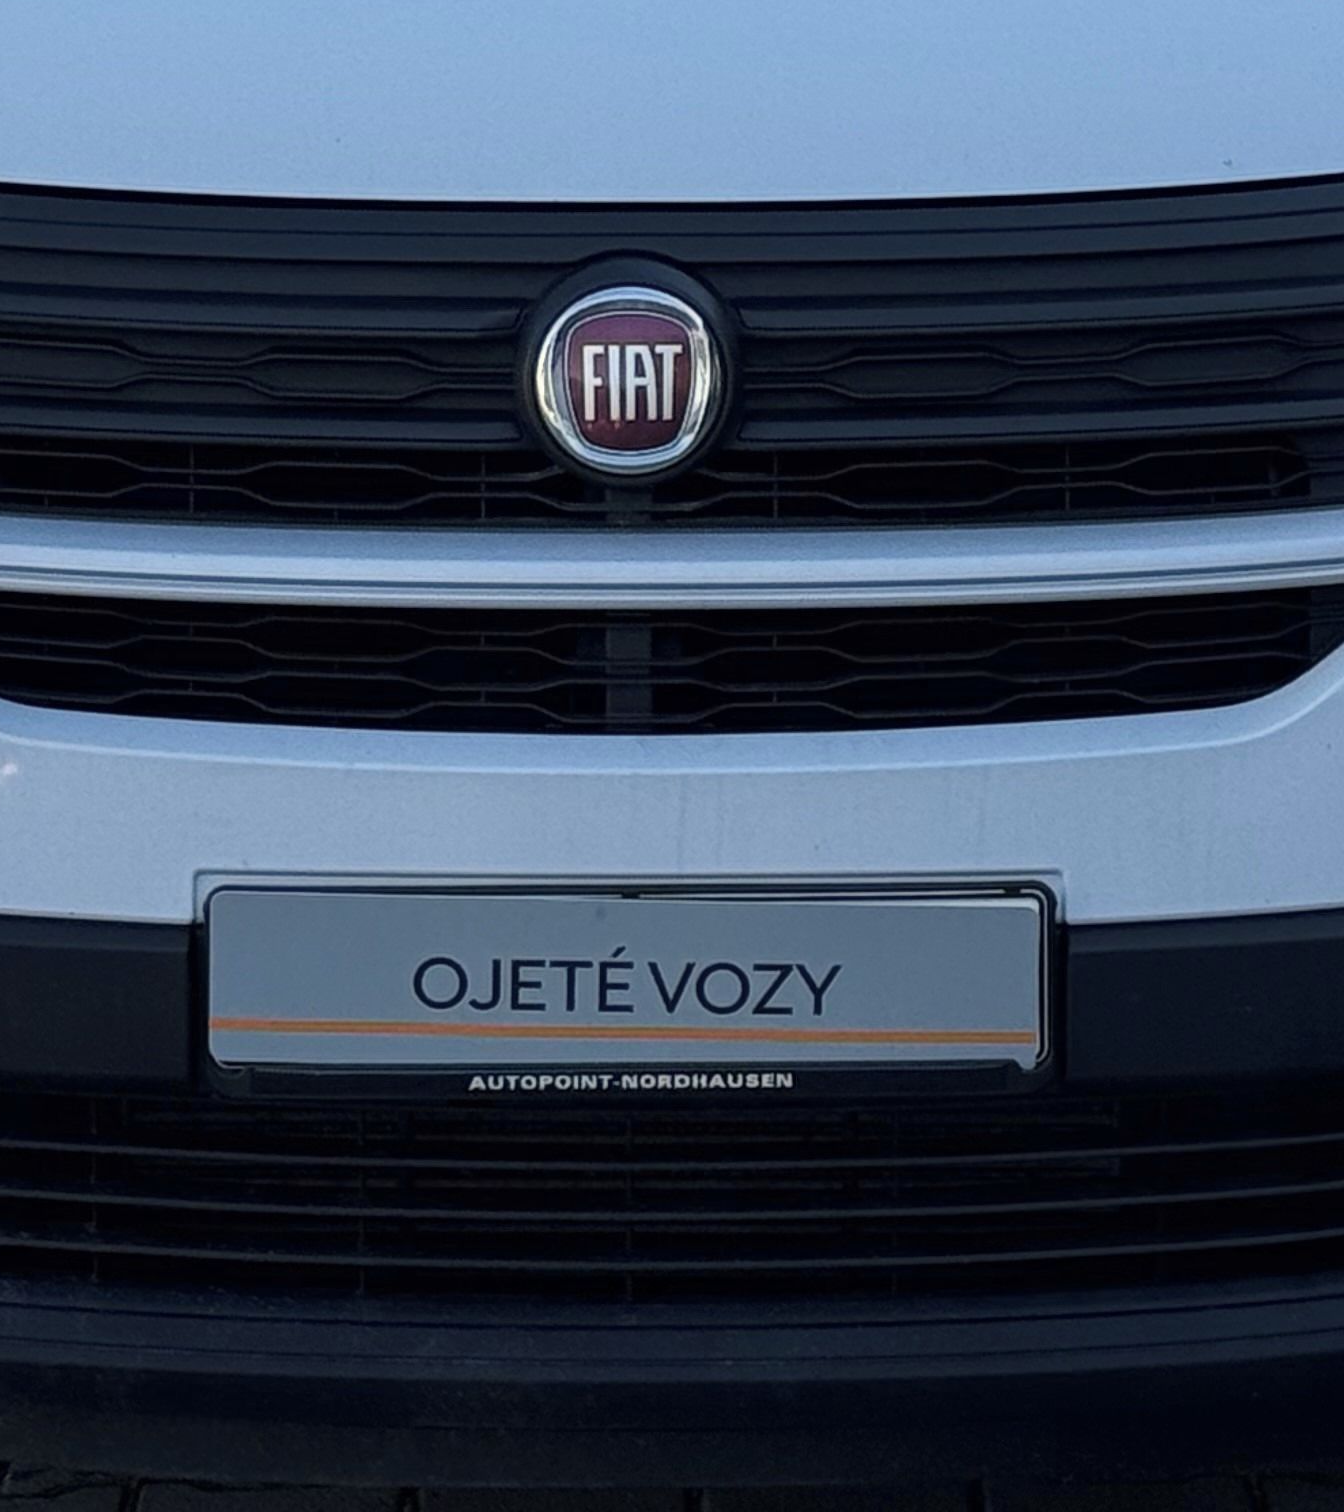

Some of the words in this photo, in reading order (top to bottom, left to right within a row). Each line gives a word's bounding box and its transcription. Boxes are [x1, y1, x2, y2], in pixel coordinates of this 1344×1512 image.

[582, 344, 683, 422] FIAT
[412, 945, 635, 1013] OJETÉ
[647, 961, 843, 1017] VOZY
[468, 1073, 793, 1091] AUTOPOINT-NORDHAUSEN
